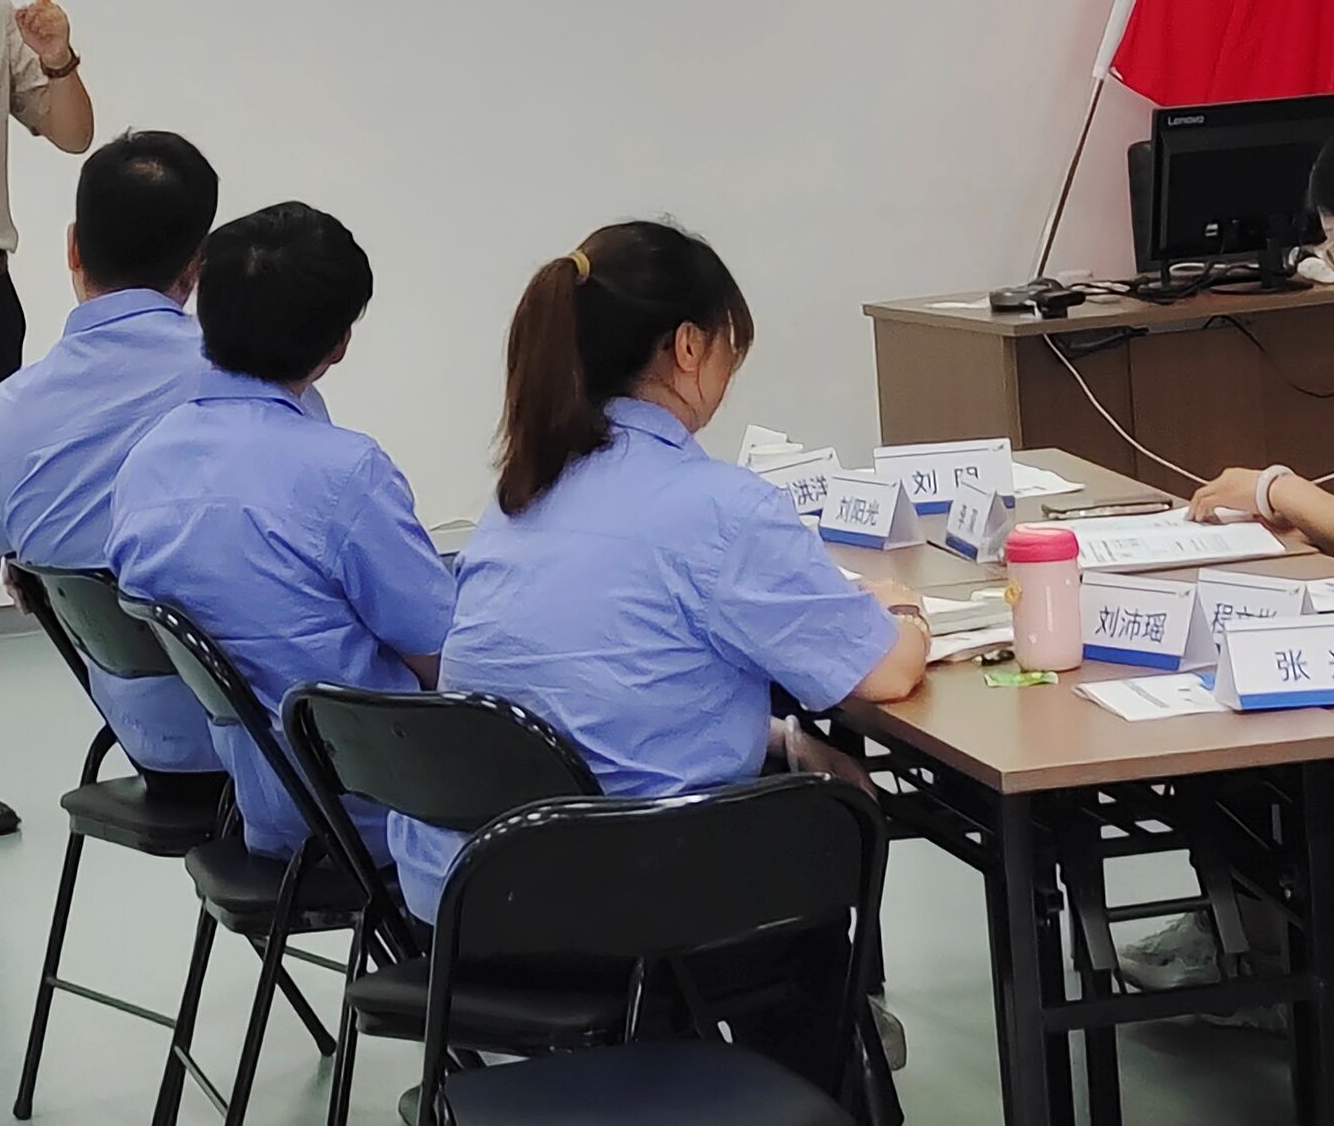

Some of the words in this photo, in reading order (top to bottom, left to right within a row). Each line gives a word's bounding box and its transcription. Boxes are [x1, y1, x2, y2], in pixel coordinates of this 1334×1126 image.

[1168, 115, 1204, 126] Lenovo
[835, 495, 880, 527] 刘阳光
[1095, 605, 1168, 643] 刘沛瑶
